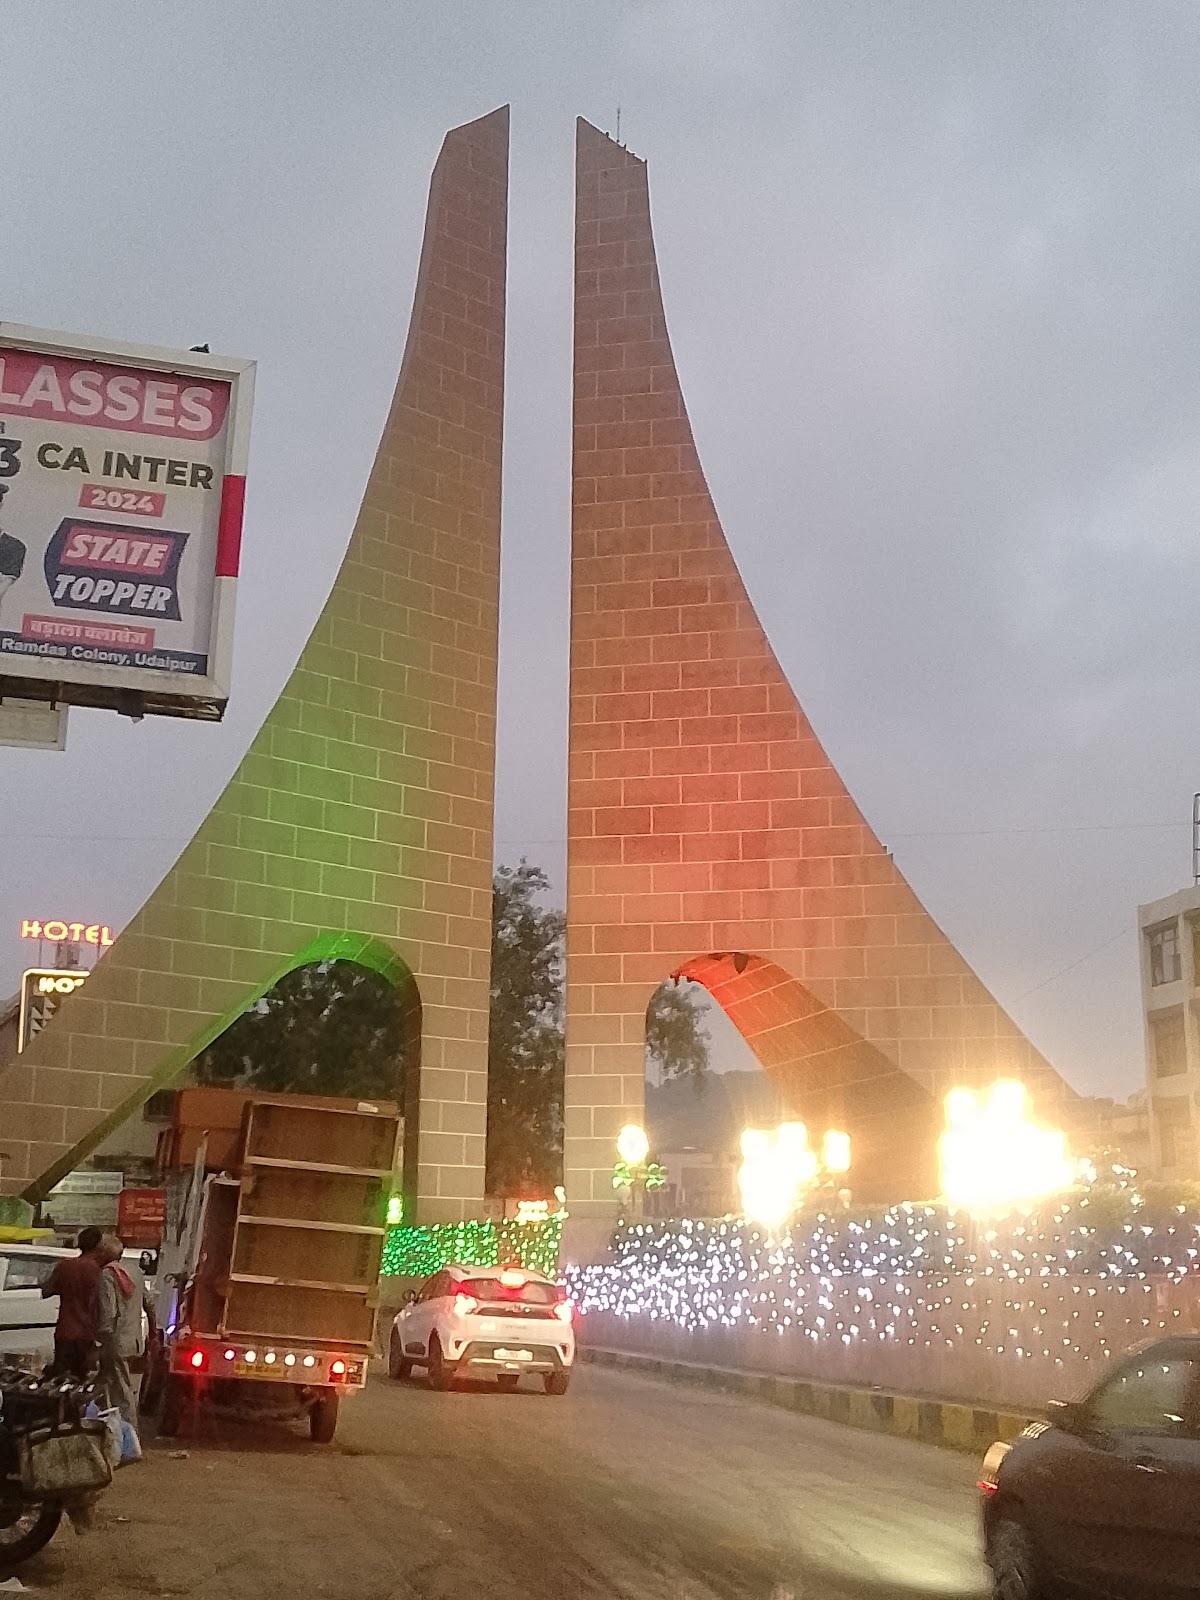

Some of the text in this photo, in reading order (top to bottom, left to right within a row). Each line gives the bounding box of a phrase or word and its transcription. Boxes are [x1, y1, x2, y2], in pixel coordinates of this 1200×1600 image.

[37, 443, 214, 489] CA INTER
[91, 489, 154, 512] 2024
[66, 534, 169, 568] STATE
[53, 574, 173, 611] TOPPER
[1, 638, 67, 656] Ramdas
[135, 653, 197, 671] Udaipur
[21, 920, 115, 946] HOTEL
